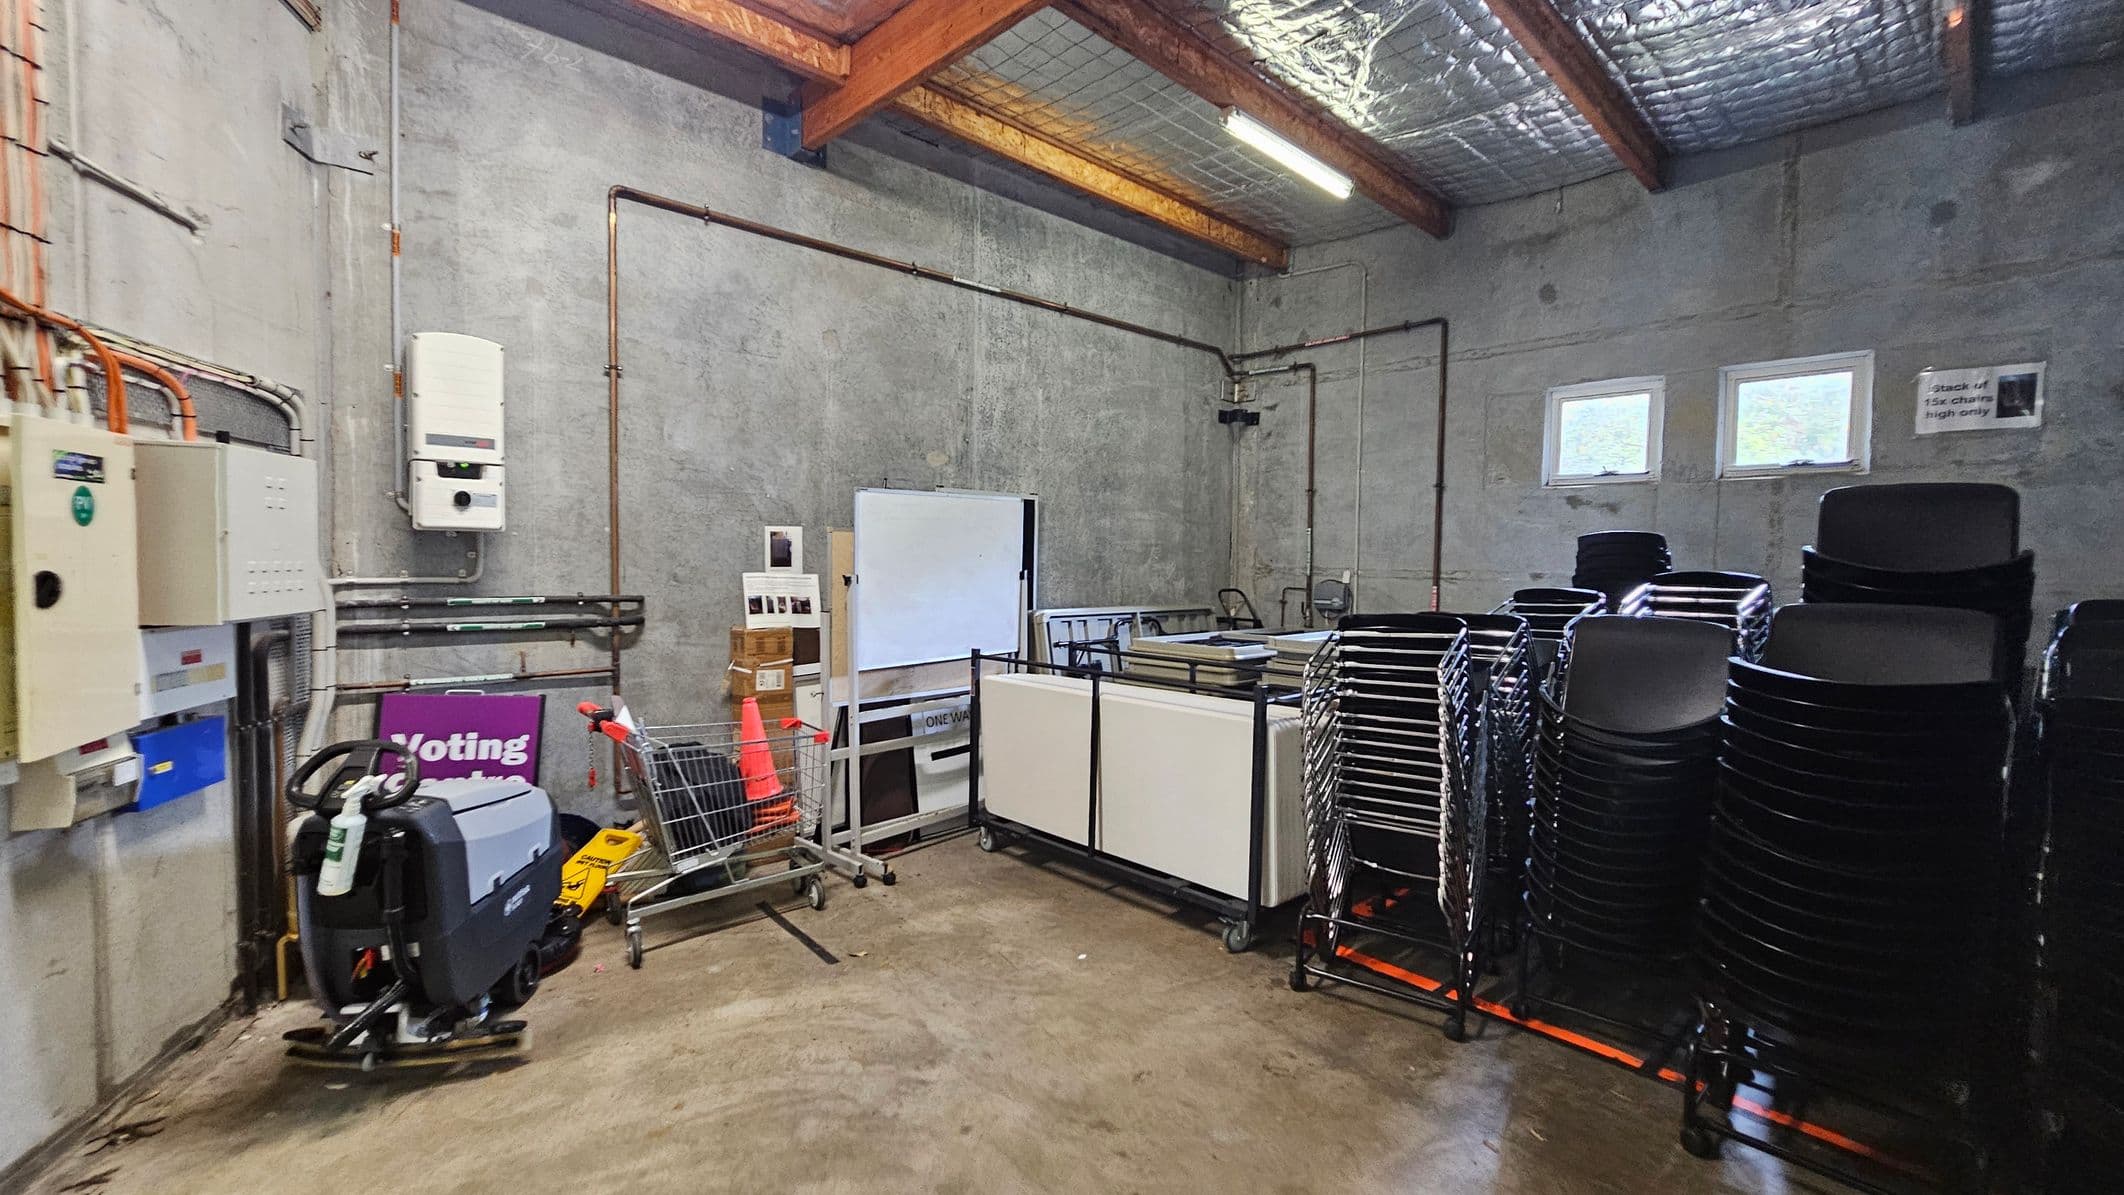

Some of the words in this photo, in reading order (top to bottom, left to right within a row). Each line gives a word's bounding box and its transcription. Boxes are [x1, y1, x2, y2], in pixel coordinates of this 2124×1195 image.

[1926, 409, 1955, 420] high
[1959, 408, 1990, 418] only
[926, 713, 949, 728] ONE
[950, 710, 971, 724] WA
[390, 732, 530, 766] Voting
